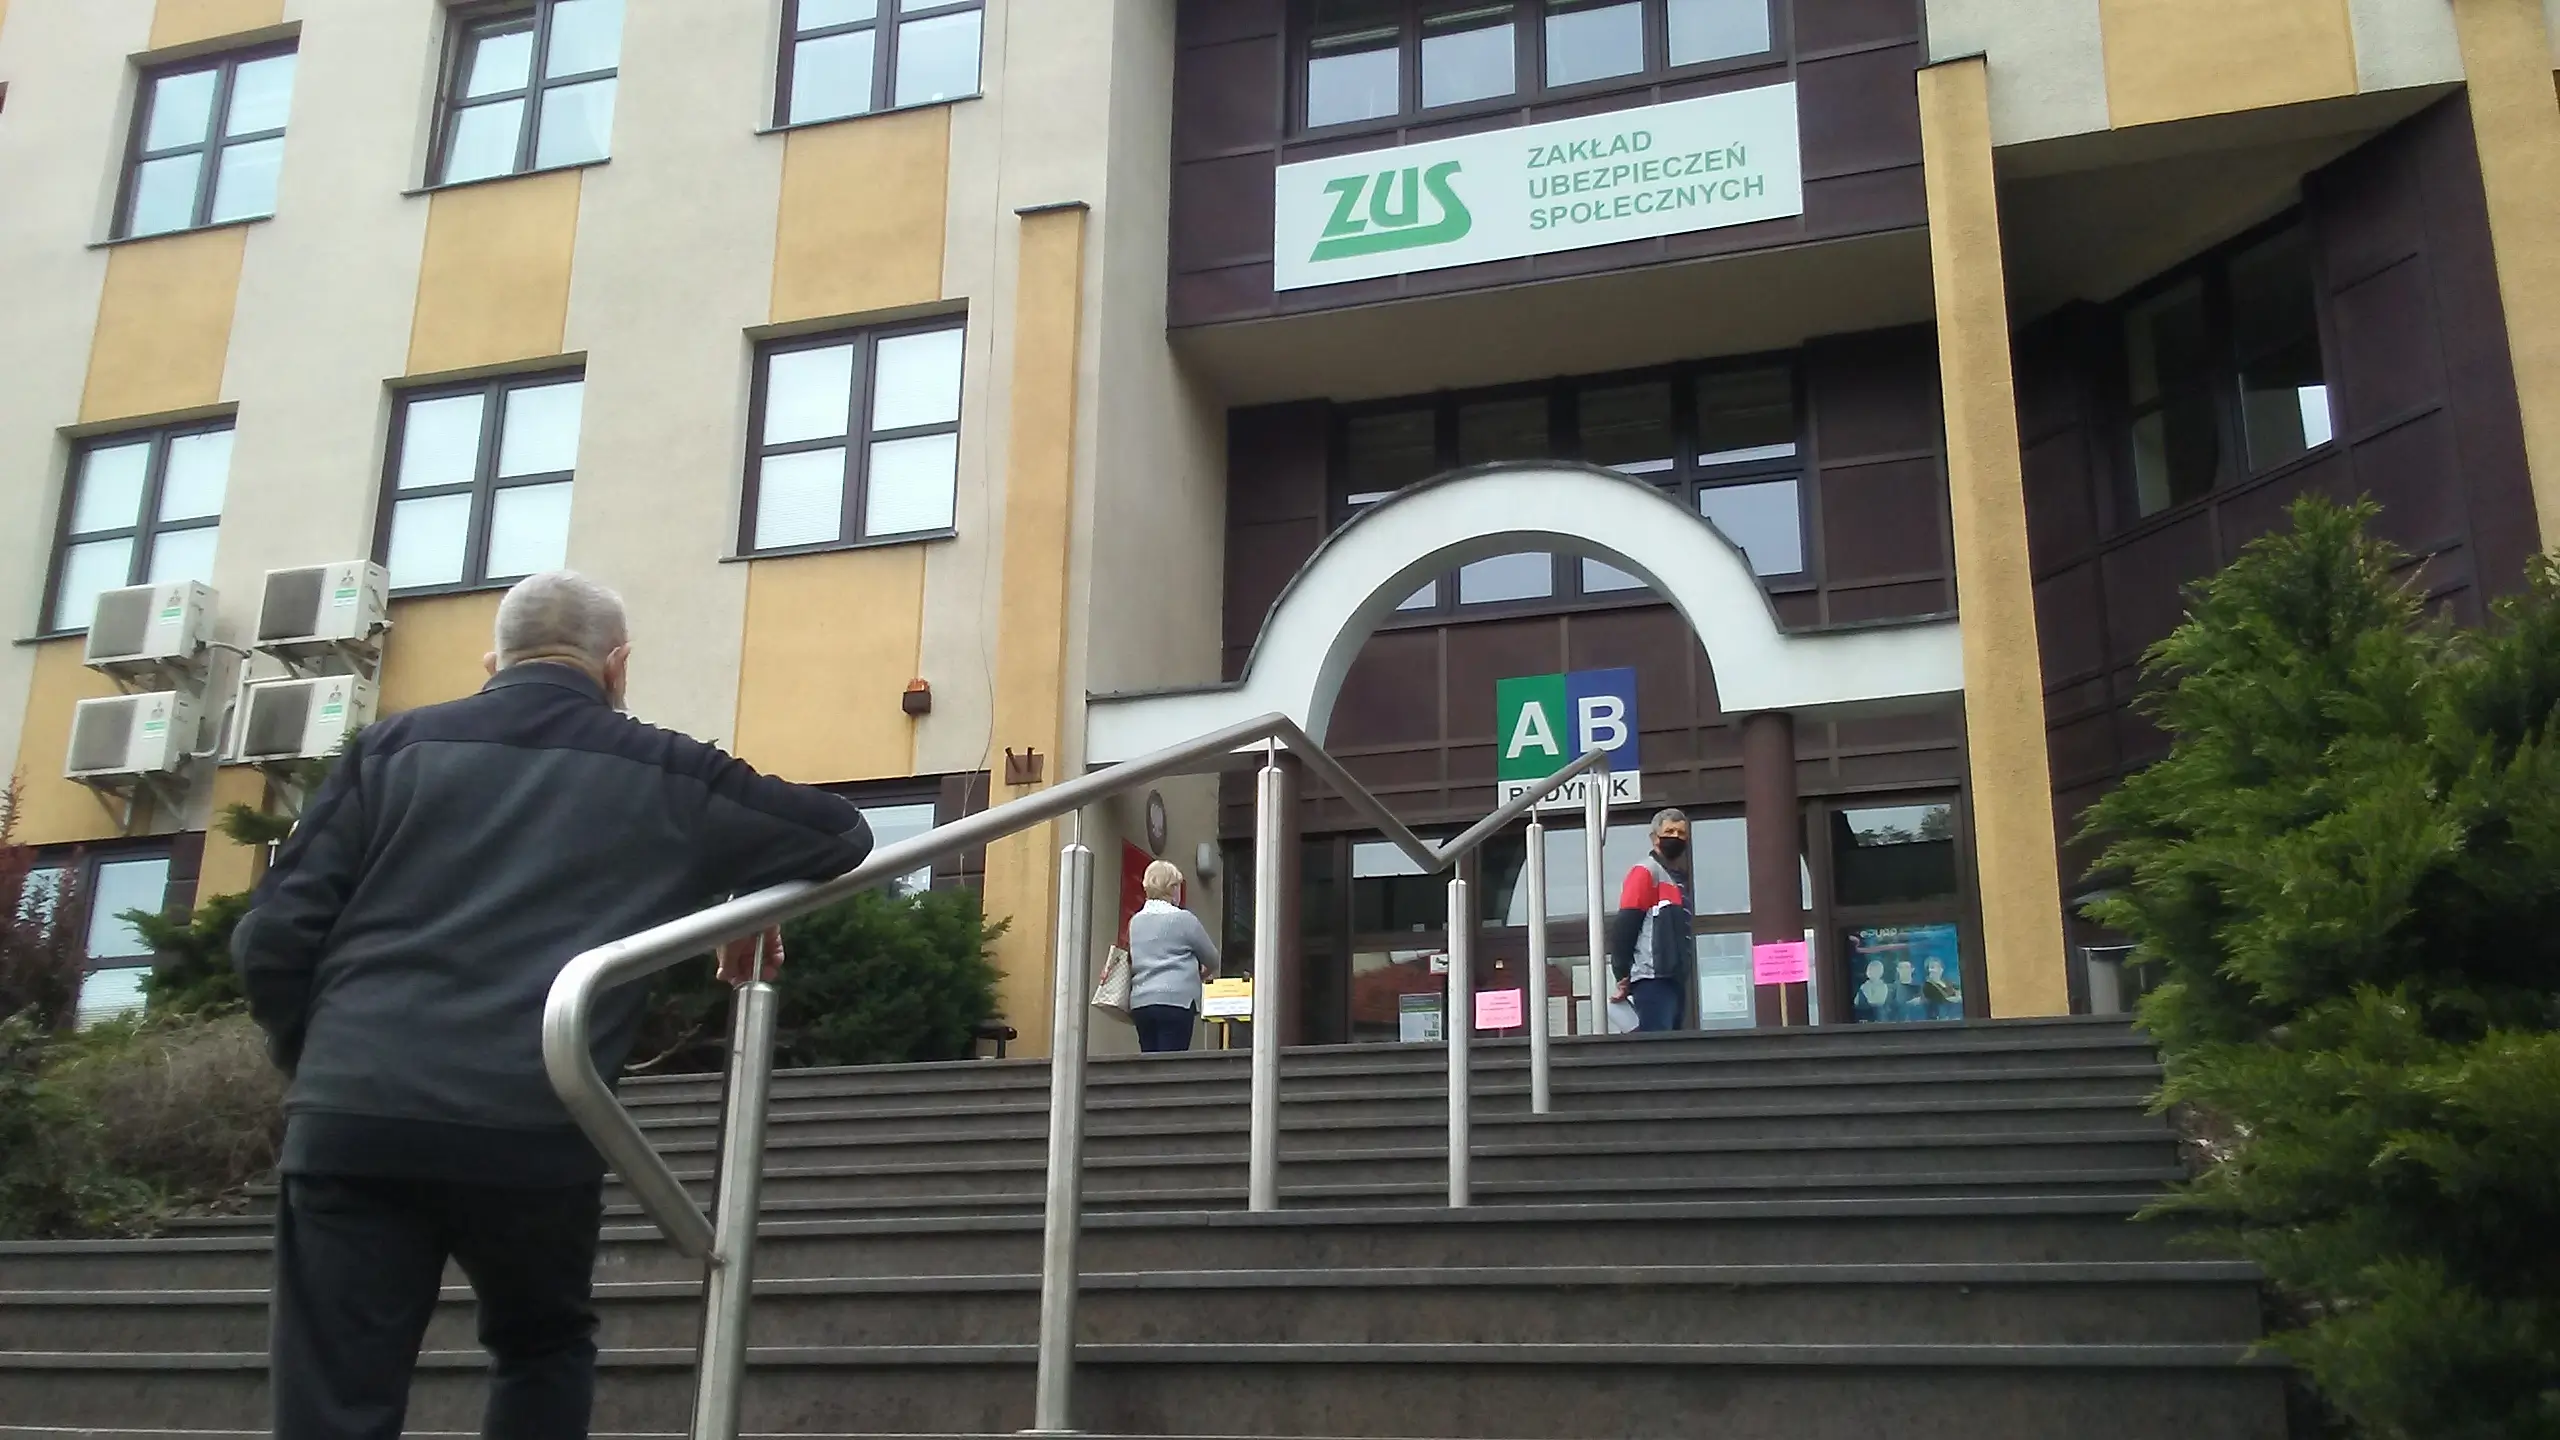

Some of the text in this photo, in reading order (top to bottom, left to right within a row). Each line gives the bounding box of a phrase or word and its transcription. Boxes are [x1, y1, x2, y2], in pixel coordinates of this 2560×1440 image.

[1527, 129, 1653, 169] ZAKŁAD
[1529, 141, 1747, 200] UBEZPIECZEŃ
[1308, 160, 1472, 263] ZUS
[1529, 174, 1765, 231] SPOŁECZNYCH
[1506, 695, 1628, 759] A B
[1509, 778, 1629, 803] BDYNK
